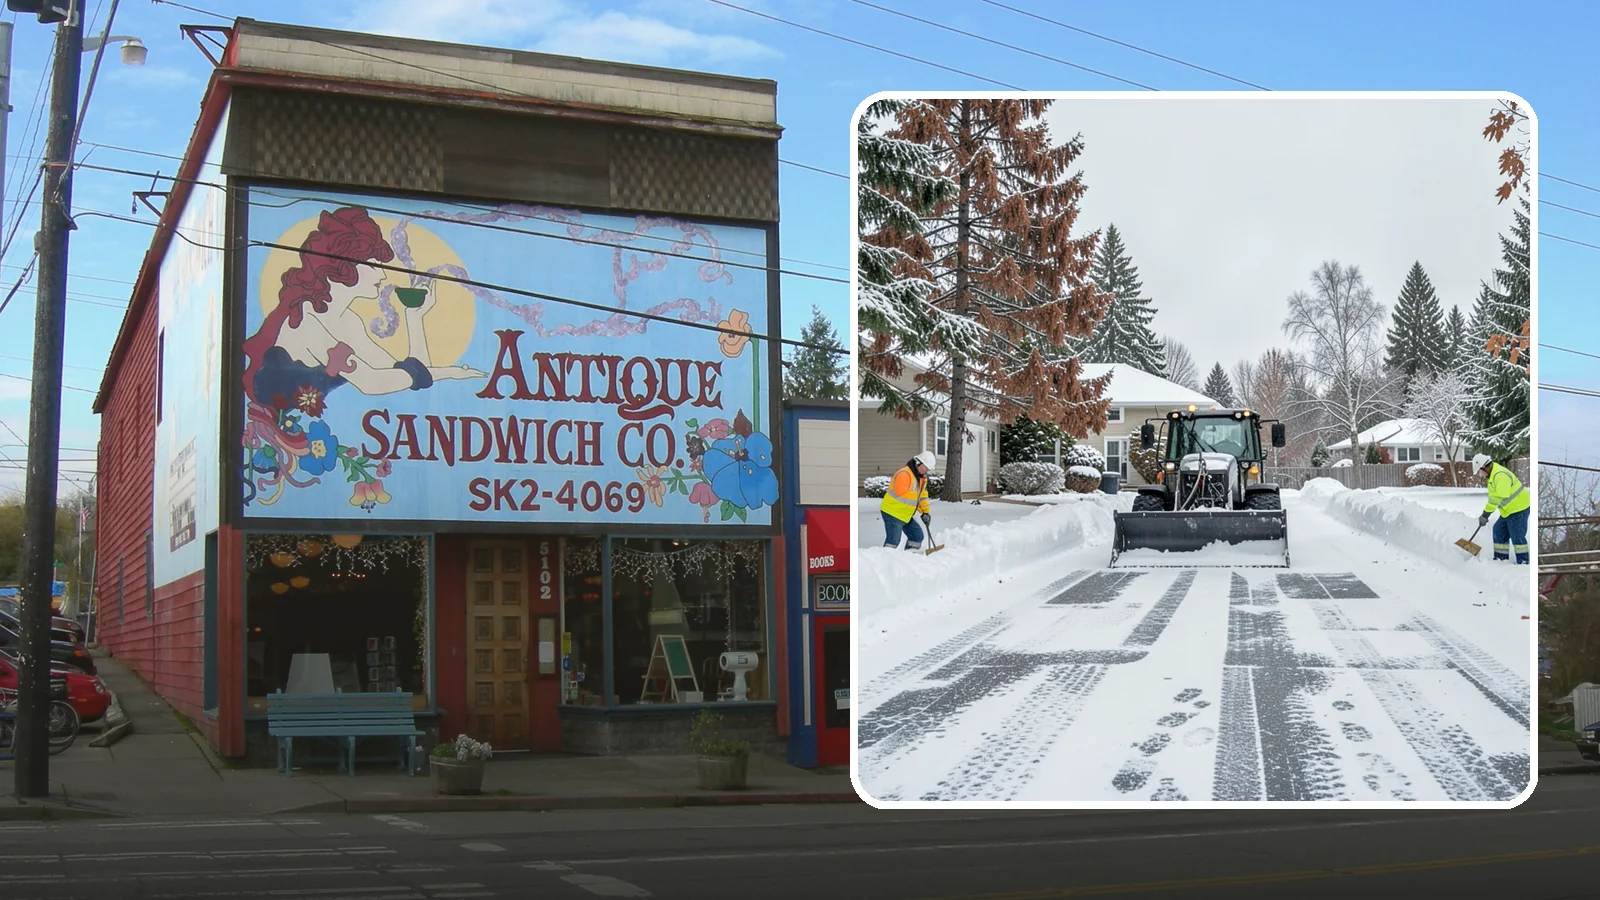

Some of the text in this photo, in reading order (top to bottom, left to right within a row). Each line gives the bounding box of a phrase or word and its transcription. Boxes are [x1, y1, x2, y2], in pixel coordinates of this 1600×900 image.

[475, 329, 723, 420] ANTIQUE
[362, 408, 685, 469] SANDWICH CO.
[468, 476, 646, 513] SK2-4069
[539, 541, 551, 600] 5102
[809, 555, 835, 569] BOOKS
